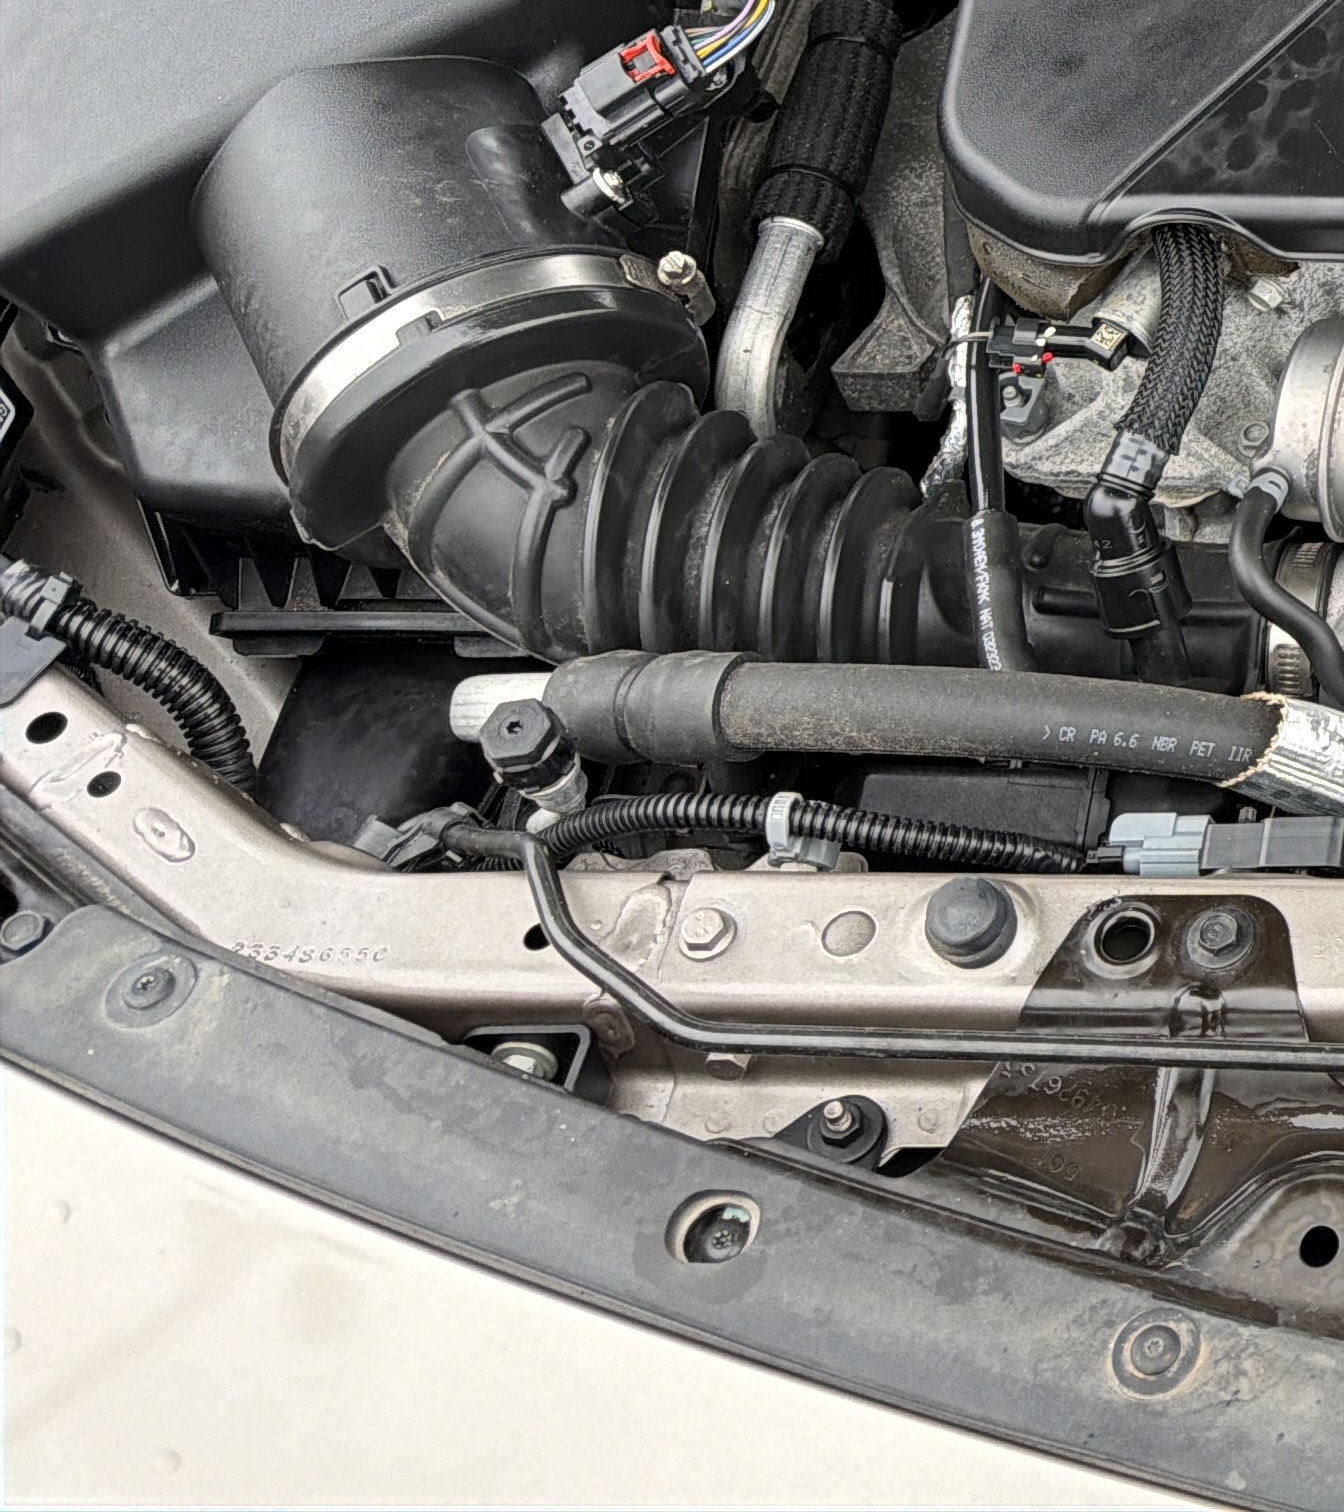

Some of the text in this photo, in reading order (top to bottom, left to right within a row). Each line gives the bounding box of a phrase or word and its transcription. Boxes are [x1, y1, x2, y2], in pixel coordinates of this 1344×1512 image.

[1058, 726, 1077, 744] CR
[1089, 728, 1107, 746] PA
[1113, 731, 1140, 750] 6.6
[1151, 734, 1178, 753] NBR
[1188, 739, 1217, 758] PET
[1227, 745, 1255, 764] IIR
